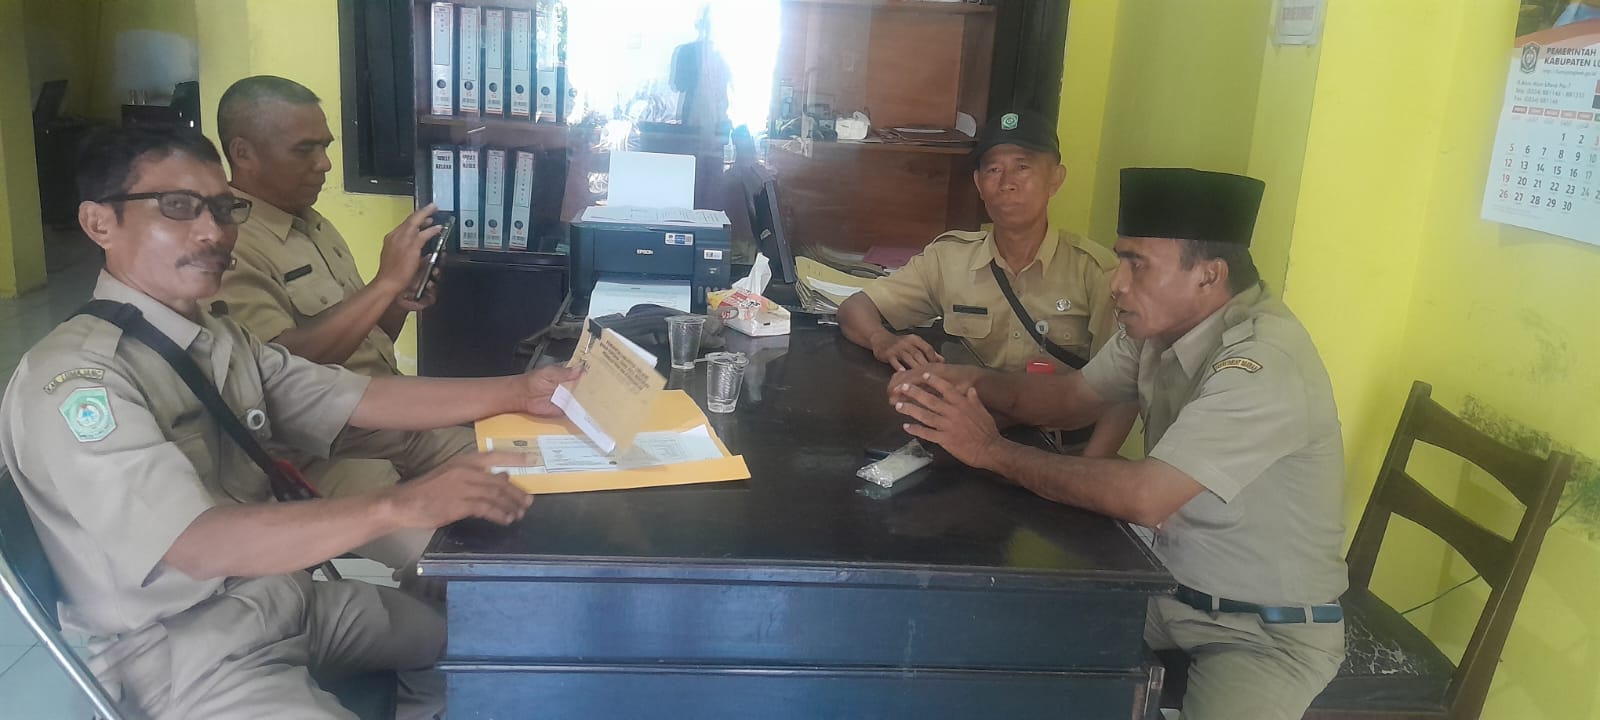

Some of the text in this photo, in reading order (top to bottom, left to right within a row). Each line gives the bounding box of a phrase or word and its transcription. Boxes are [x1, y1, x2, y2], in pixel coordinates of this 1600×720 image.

[1547, 48, 1596, 56] PEMERINTAH
[1544, 58, 1590, 66] KABUPATEN
[1578, 135, 1584, 144] 2
[1525, 145, 1530, 154] 6
[1542, 147, 1547, 156] 7
[1559, 150, 1564, 159] 8
[1576, 152, 1580, 161] 9
[1590, 154, 1597, 163] 10
[1505, 159, 1592, 179] 12 13 14 15 16 17
[1502, 174, 1510, 182] 19
[1517, 176, 1527, 186] 20
[1533, 179, 1542, 188] 21
[1550, 182, 1559, 191] 22
[1566, 184, 1575, 194] 23
[1581, 187, 1589, 196] 24
[1499, 189, 1572, 211] 26 27 28 29 30
